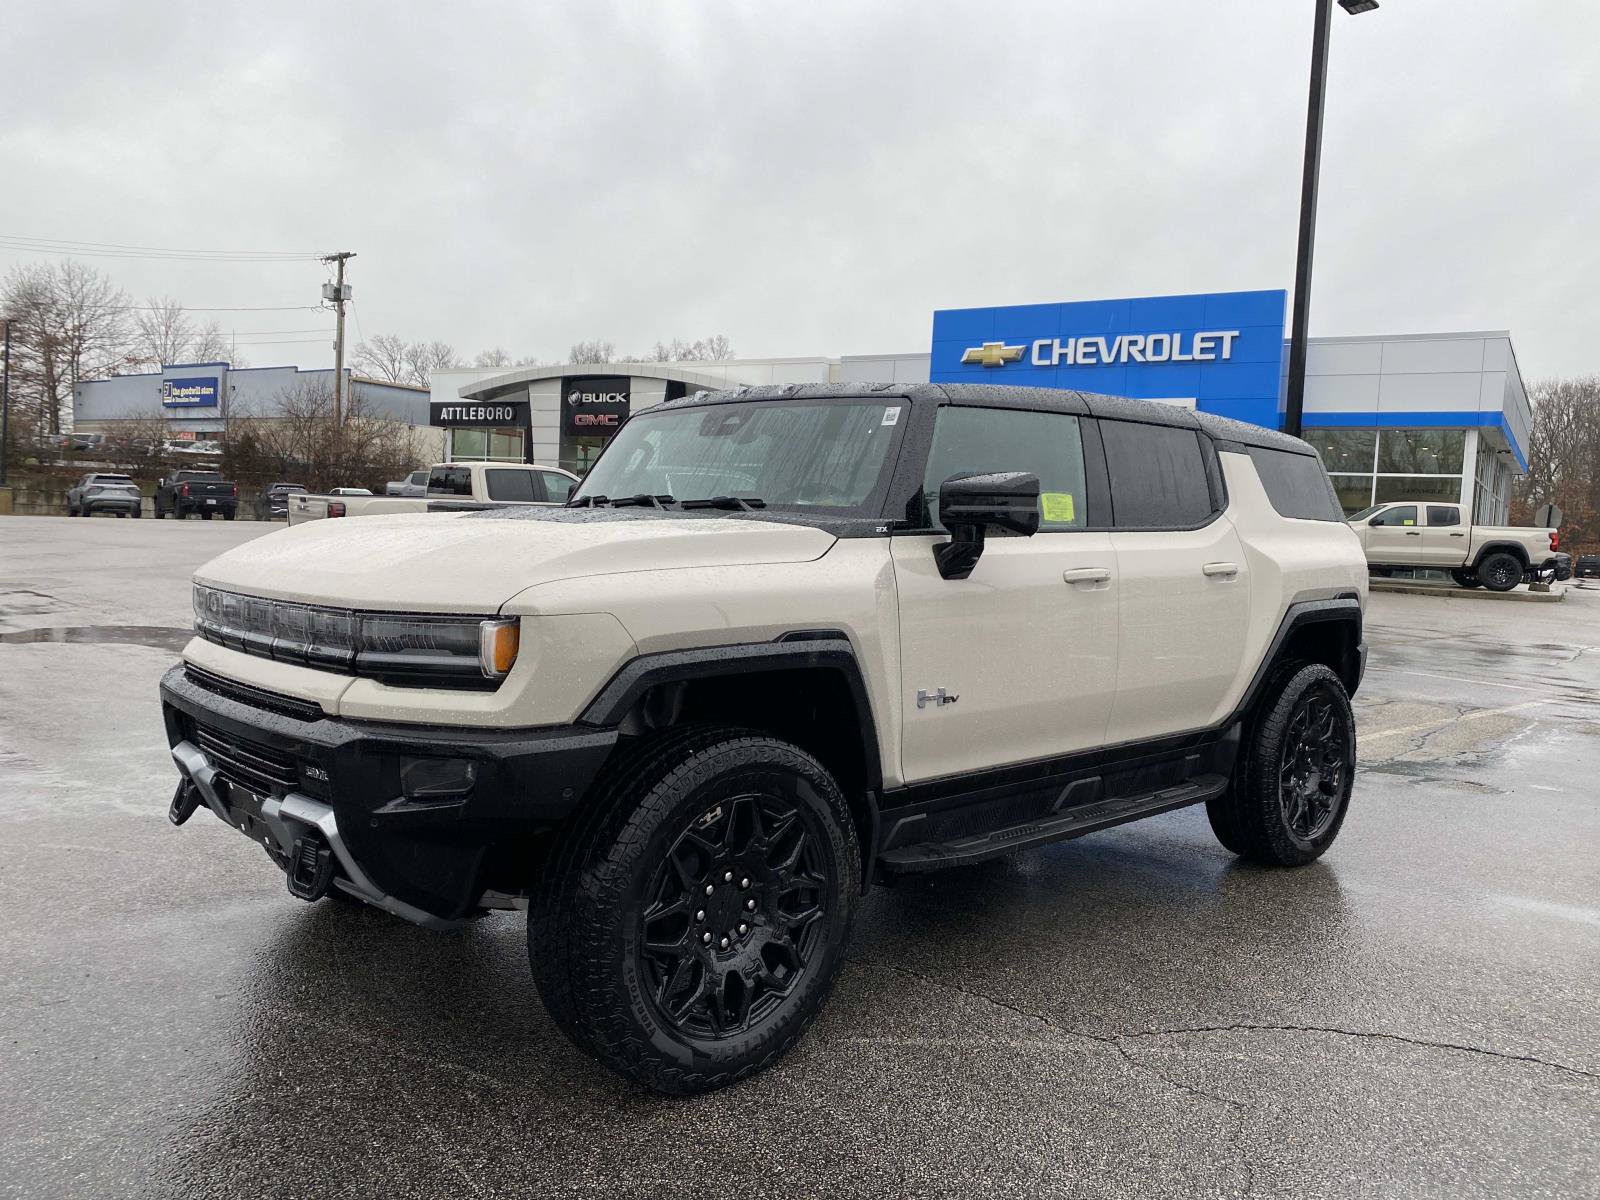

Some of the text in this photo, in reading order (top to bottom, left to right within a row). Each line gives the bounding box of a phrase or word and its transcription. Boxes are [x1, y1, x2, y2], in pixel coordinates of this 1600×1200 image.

[1031, 330, 1240, 367] CHEVROLET
[582, 392, 627, 403] BUICK
[440, 406, 513, 421] ATTLEBORO
[574, 414, 619, 426] GMC
